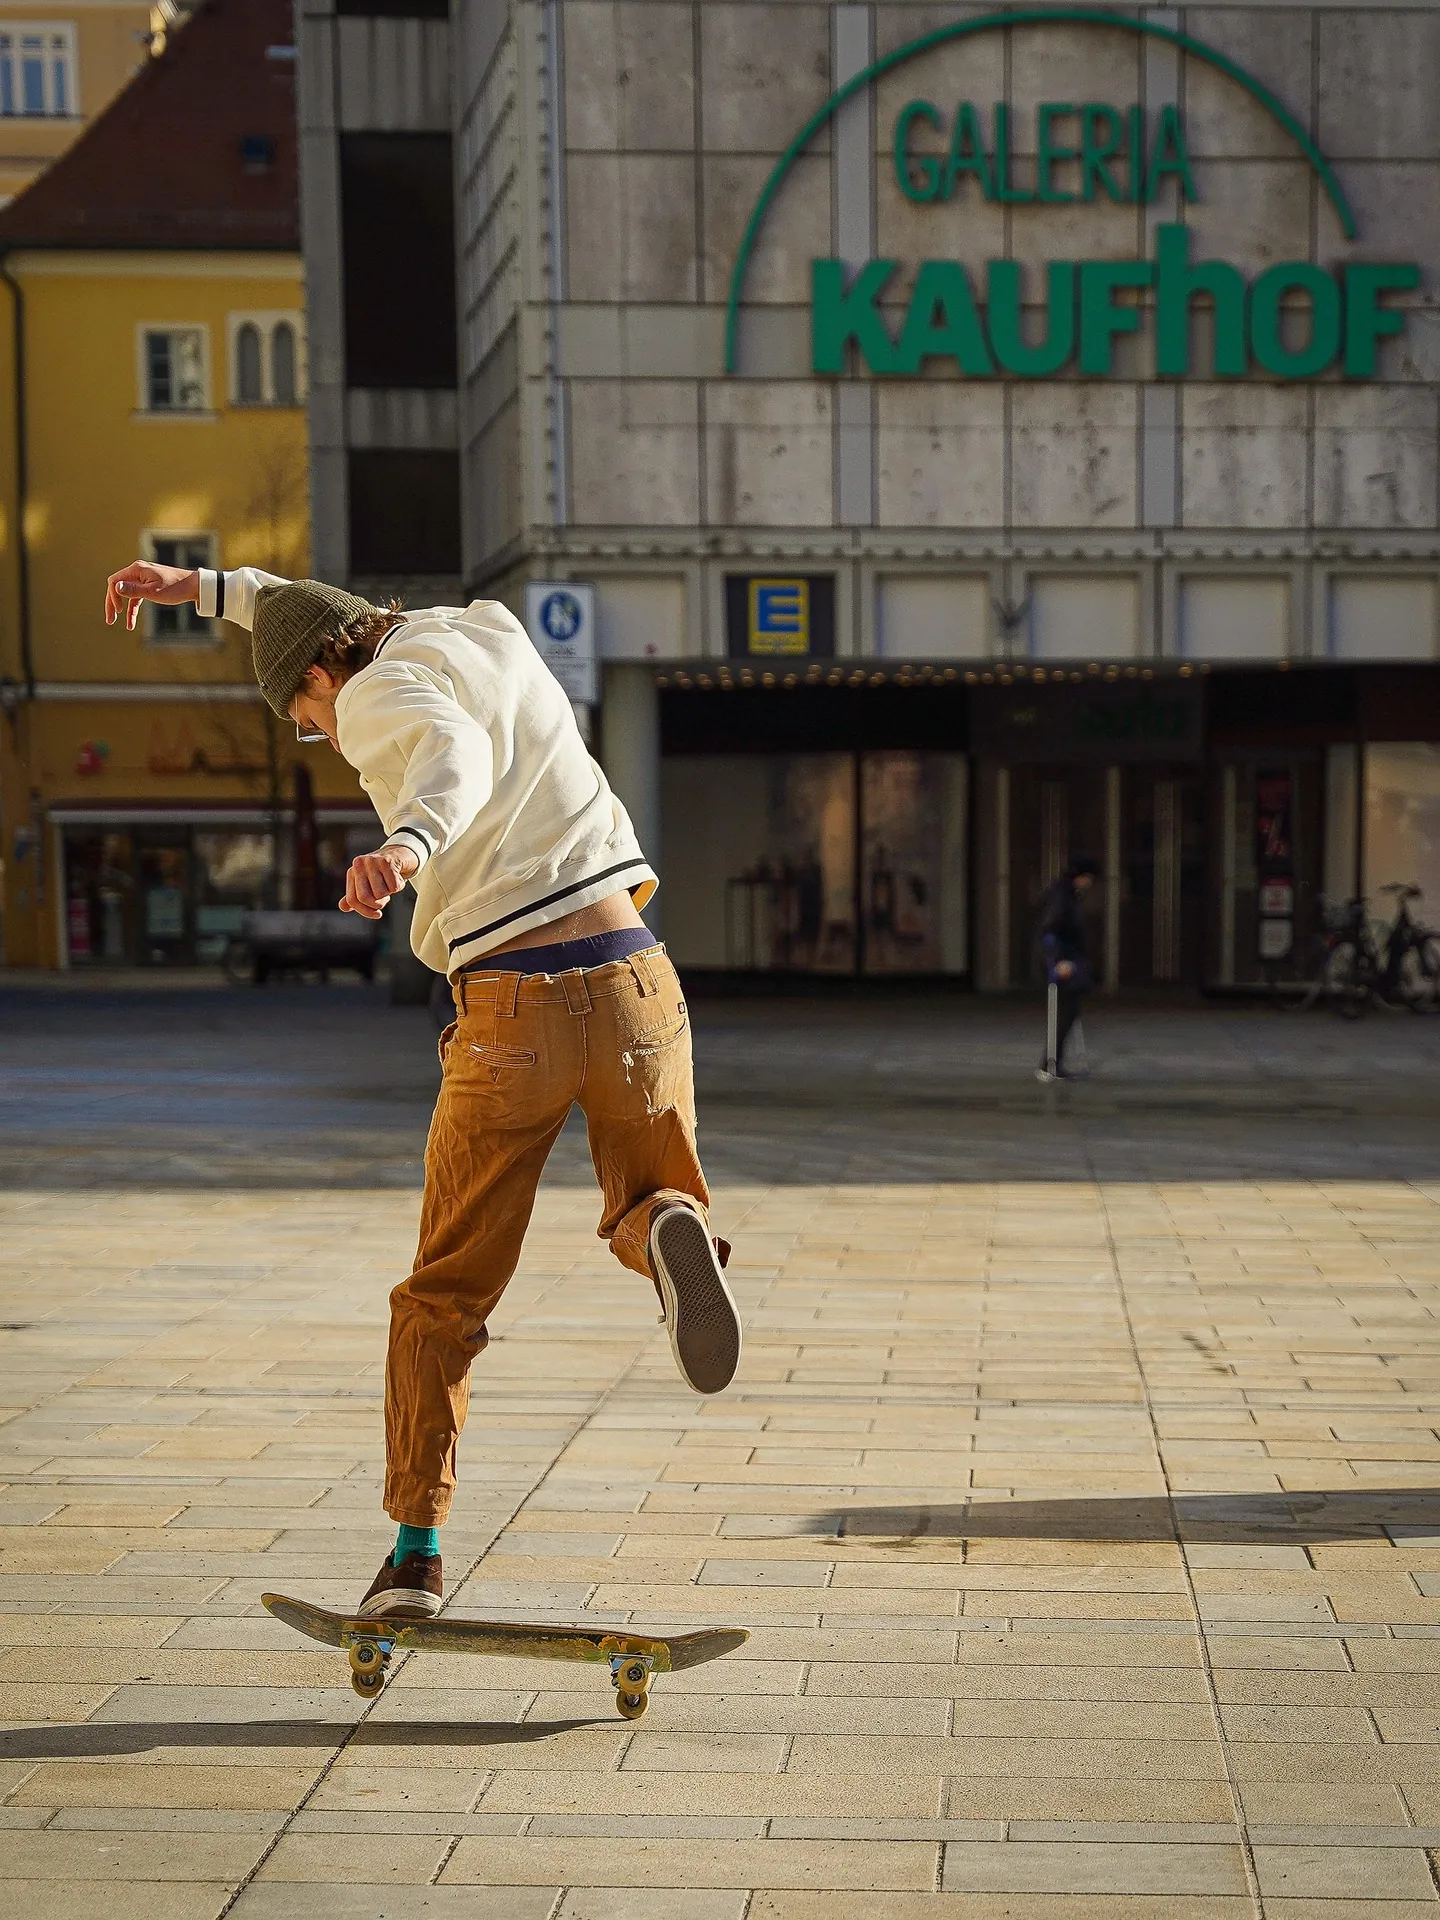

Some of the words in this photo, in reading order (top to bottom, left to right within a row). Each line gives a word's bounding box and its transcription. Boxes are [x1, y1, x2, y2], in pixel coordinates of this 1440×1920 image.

[894, 99, 1196, 203] GALERIA
[810, 223, 1420, 378] KAUFhOF
[758, 586, 800, 633] E
